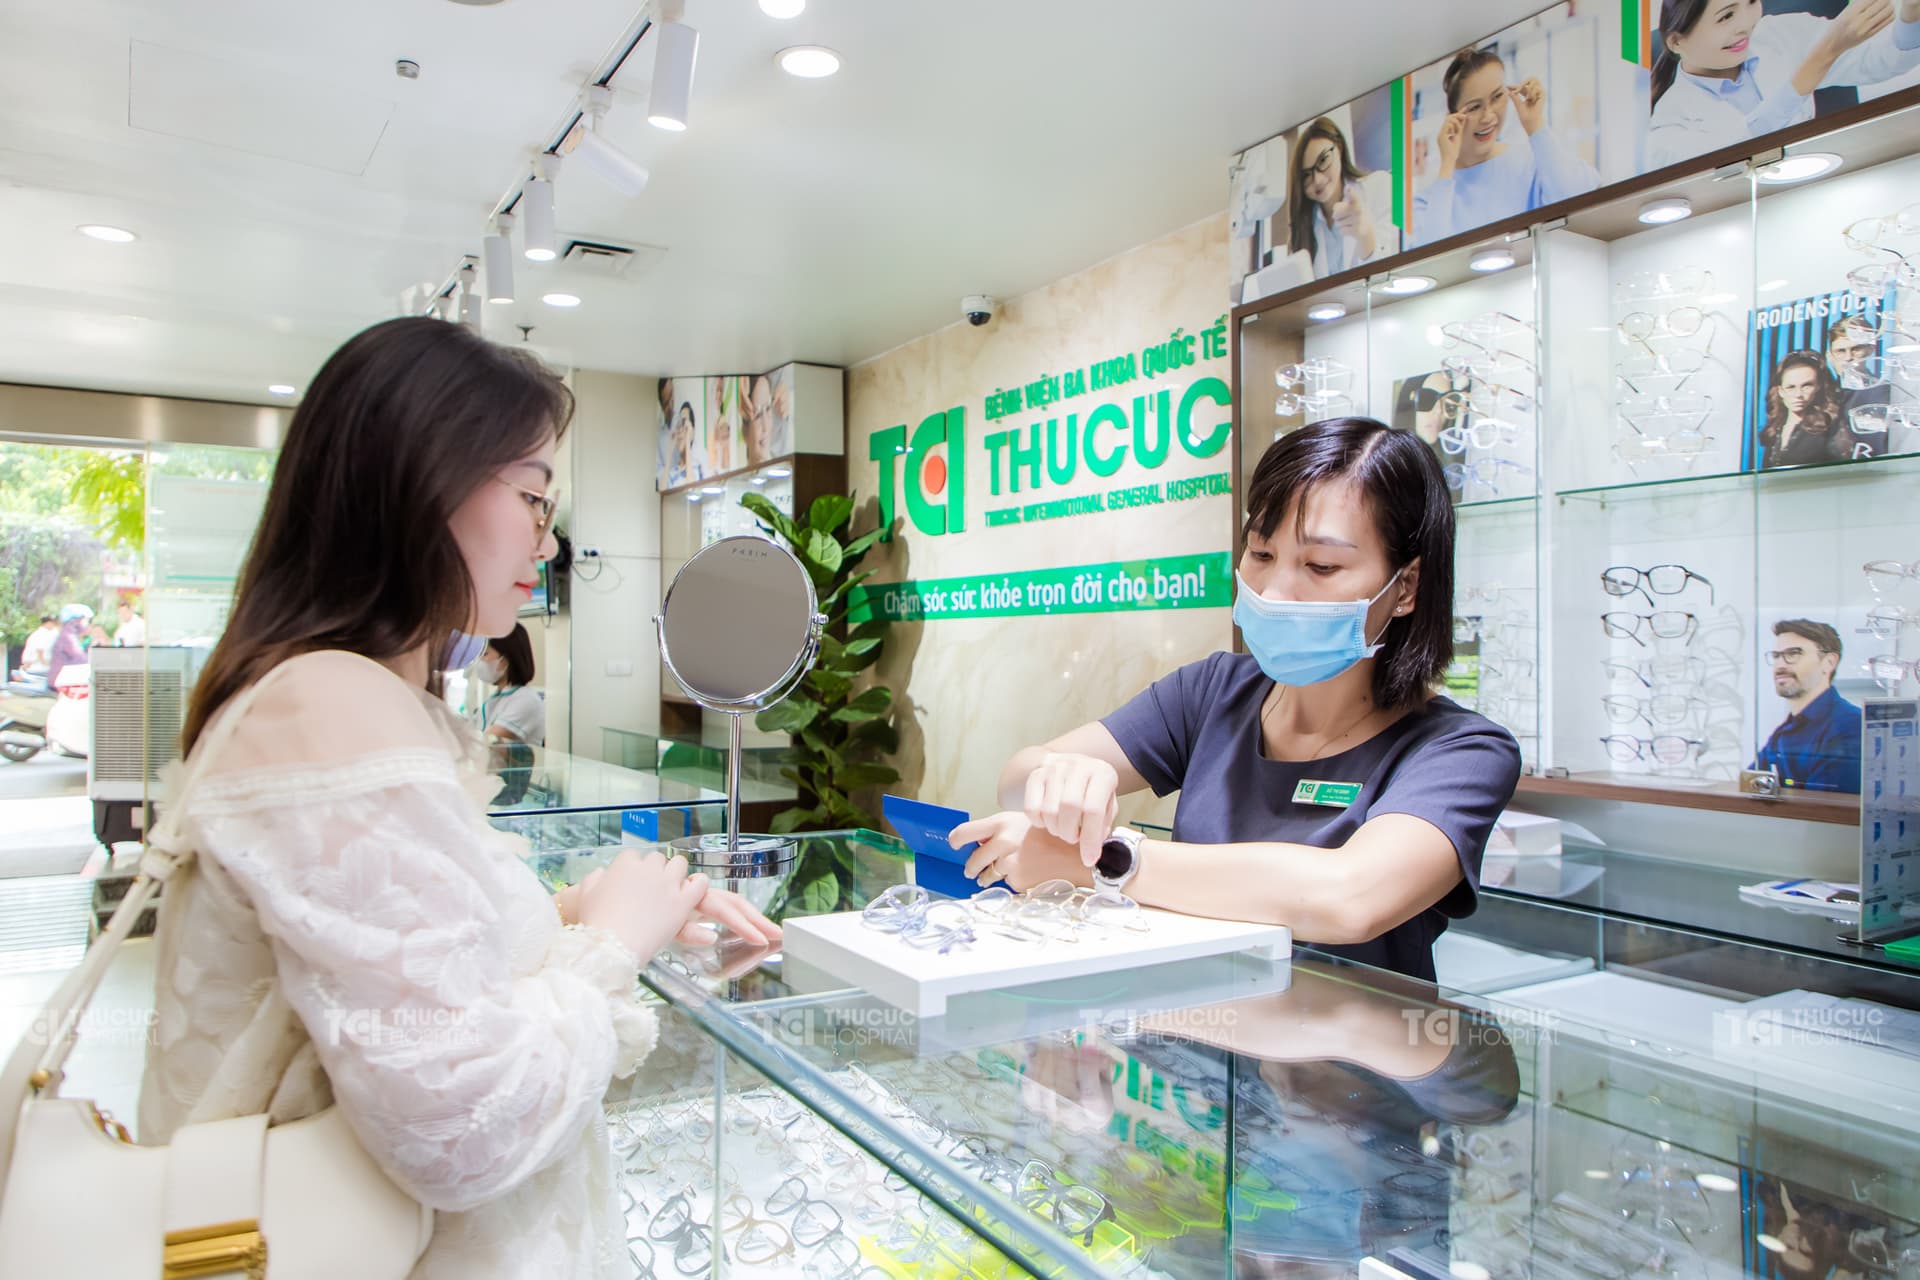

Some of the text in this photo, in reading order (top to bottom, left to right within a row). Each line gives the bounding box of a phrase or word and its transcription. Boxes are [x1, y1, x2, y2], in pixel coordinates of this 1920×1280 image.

[1090, 353, 1137, 391] KHOA
[1142, 328, 1196, 379] QUỐC
[1201, 314, 1229, 360] TẾ
[1107, 484, 1164, 511] GENERAL
[1166, 472, 1232, 501] HOSPITAL
[924, 584, 948, 612] sóc
[951, 582, 977, 611] sức
[980, 577, 1022, 608] khỏe
[1026, 582, 1066, 613] trọn
[1071, 573, 1102, 603] đời
[1108, 570, 1146, 602] cho
[1154, 564, 1206, 607] bạn!
